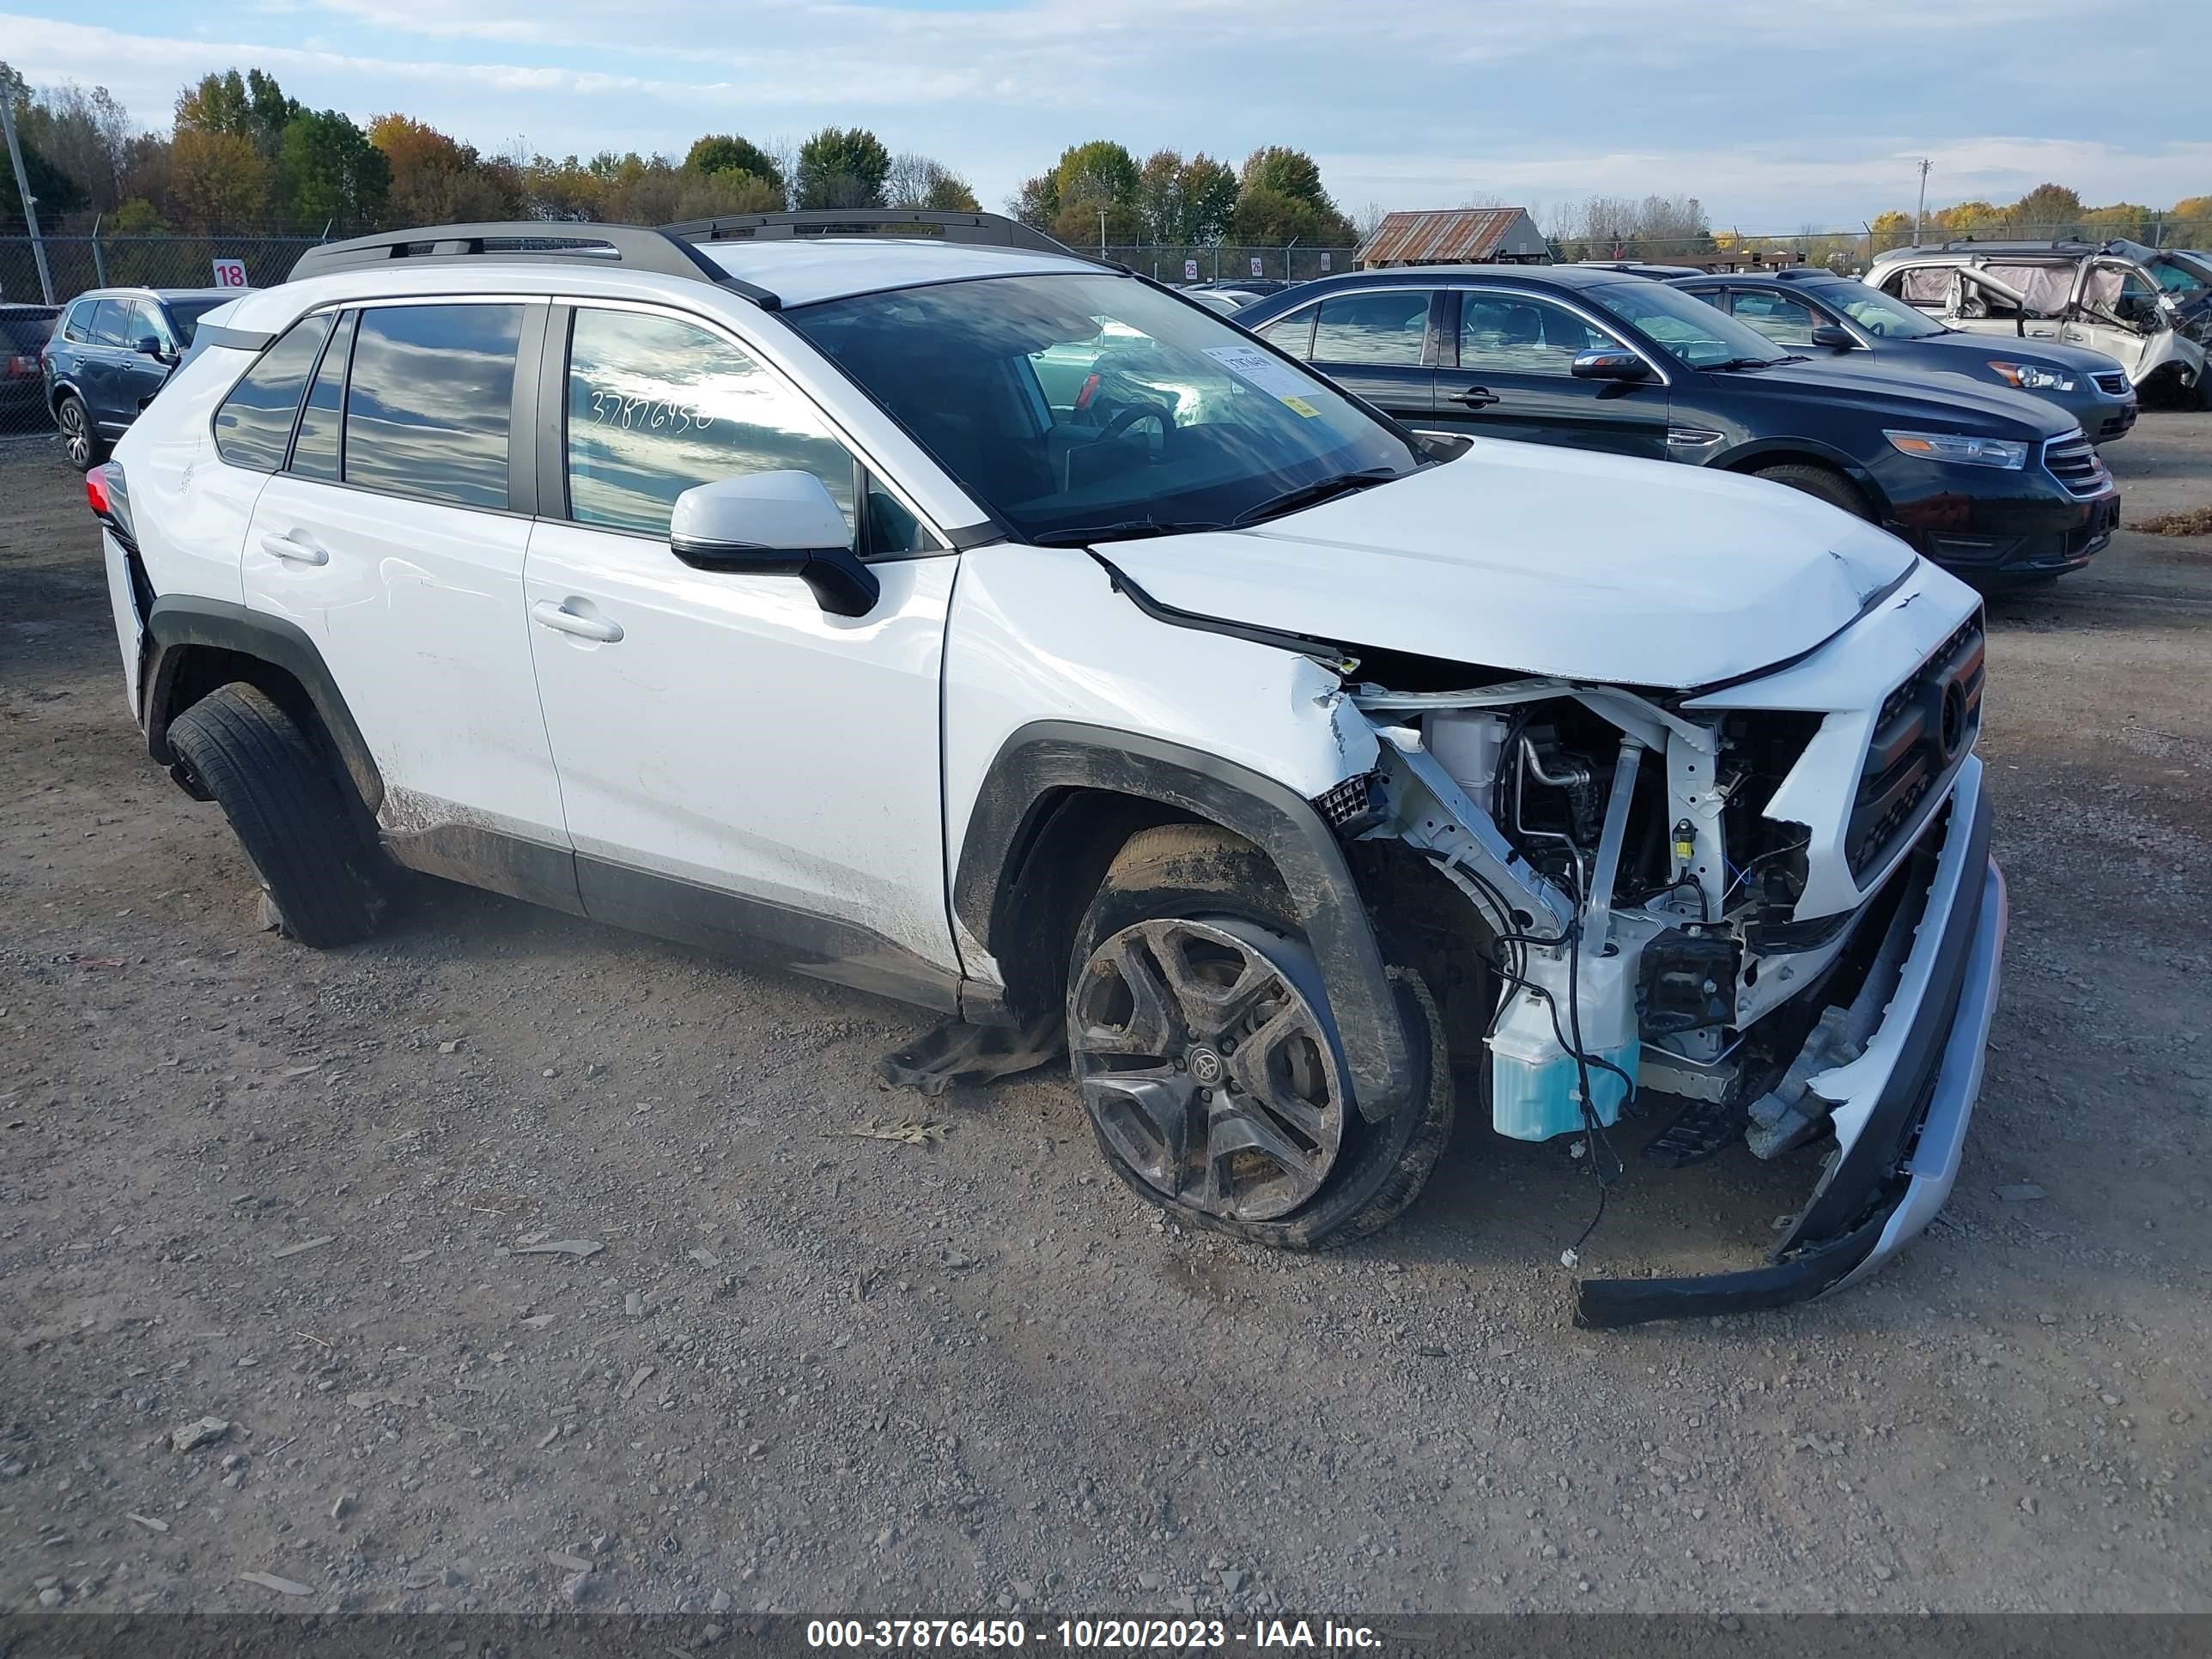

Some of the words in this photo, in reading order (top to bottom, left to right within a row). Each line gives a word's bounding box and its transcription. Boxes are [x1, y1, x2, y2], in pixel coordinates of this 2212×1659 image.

[1186, 264, 1196, 276] 25
[1252, 261, 1261, 273] 26
[216, 265, 245, 287] 18
